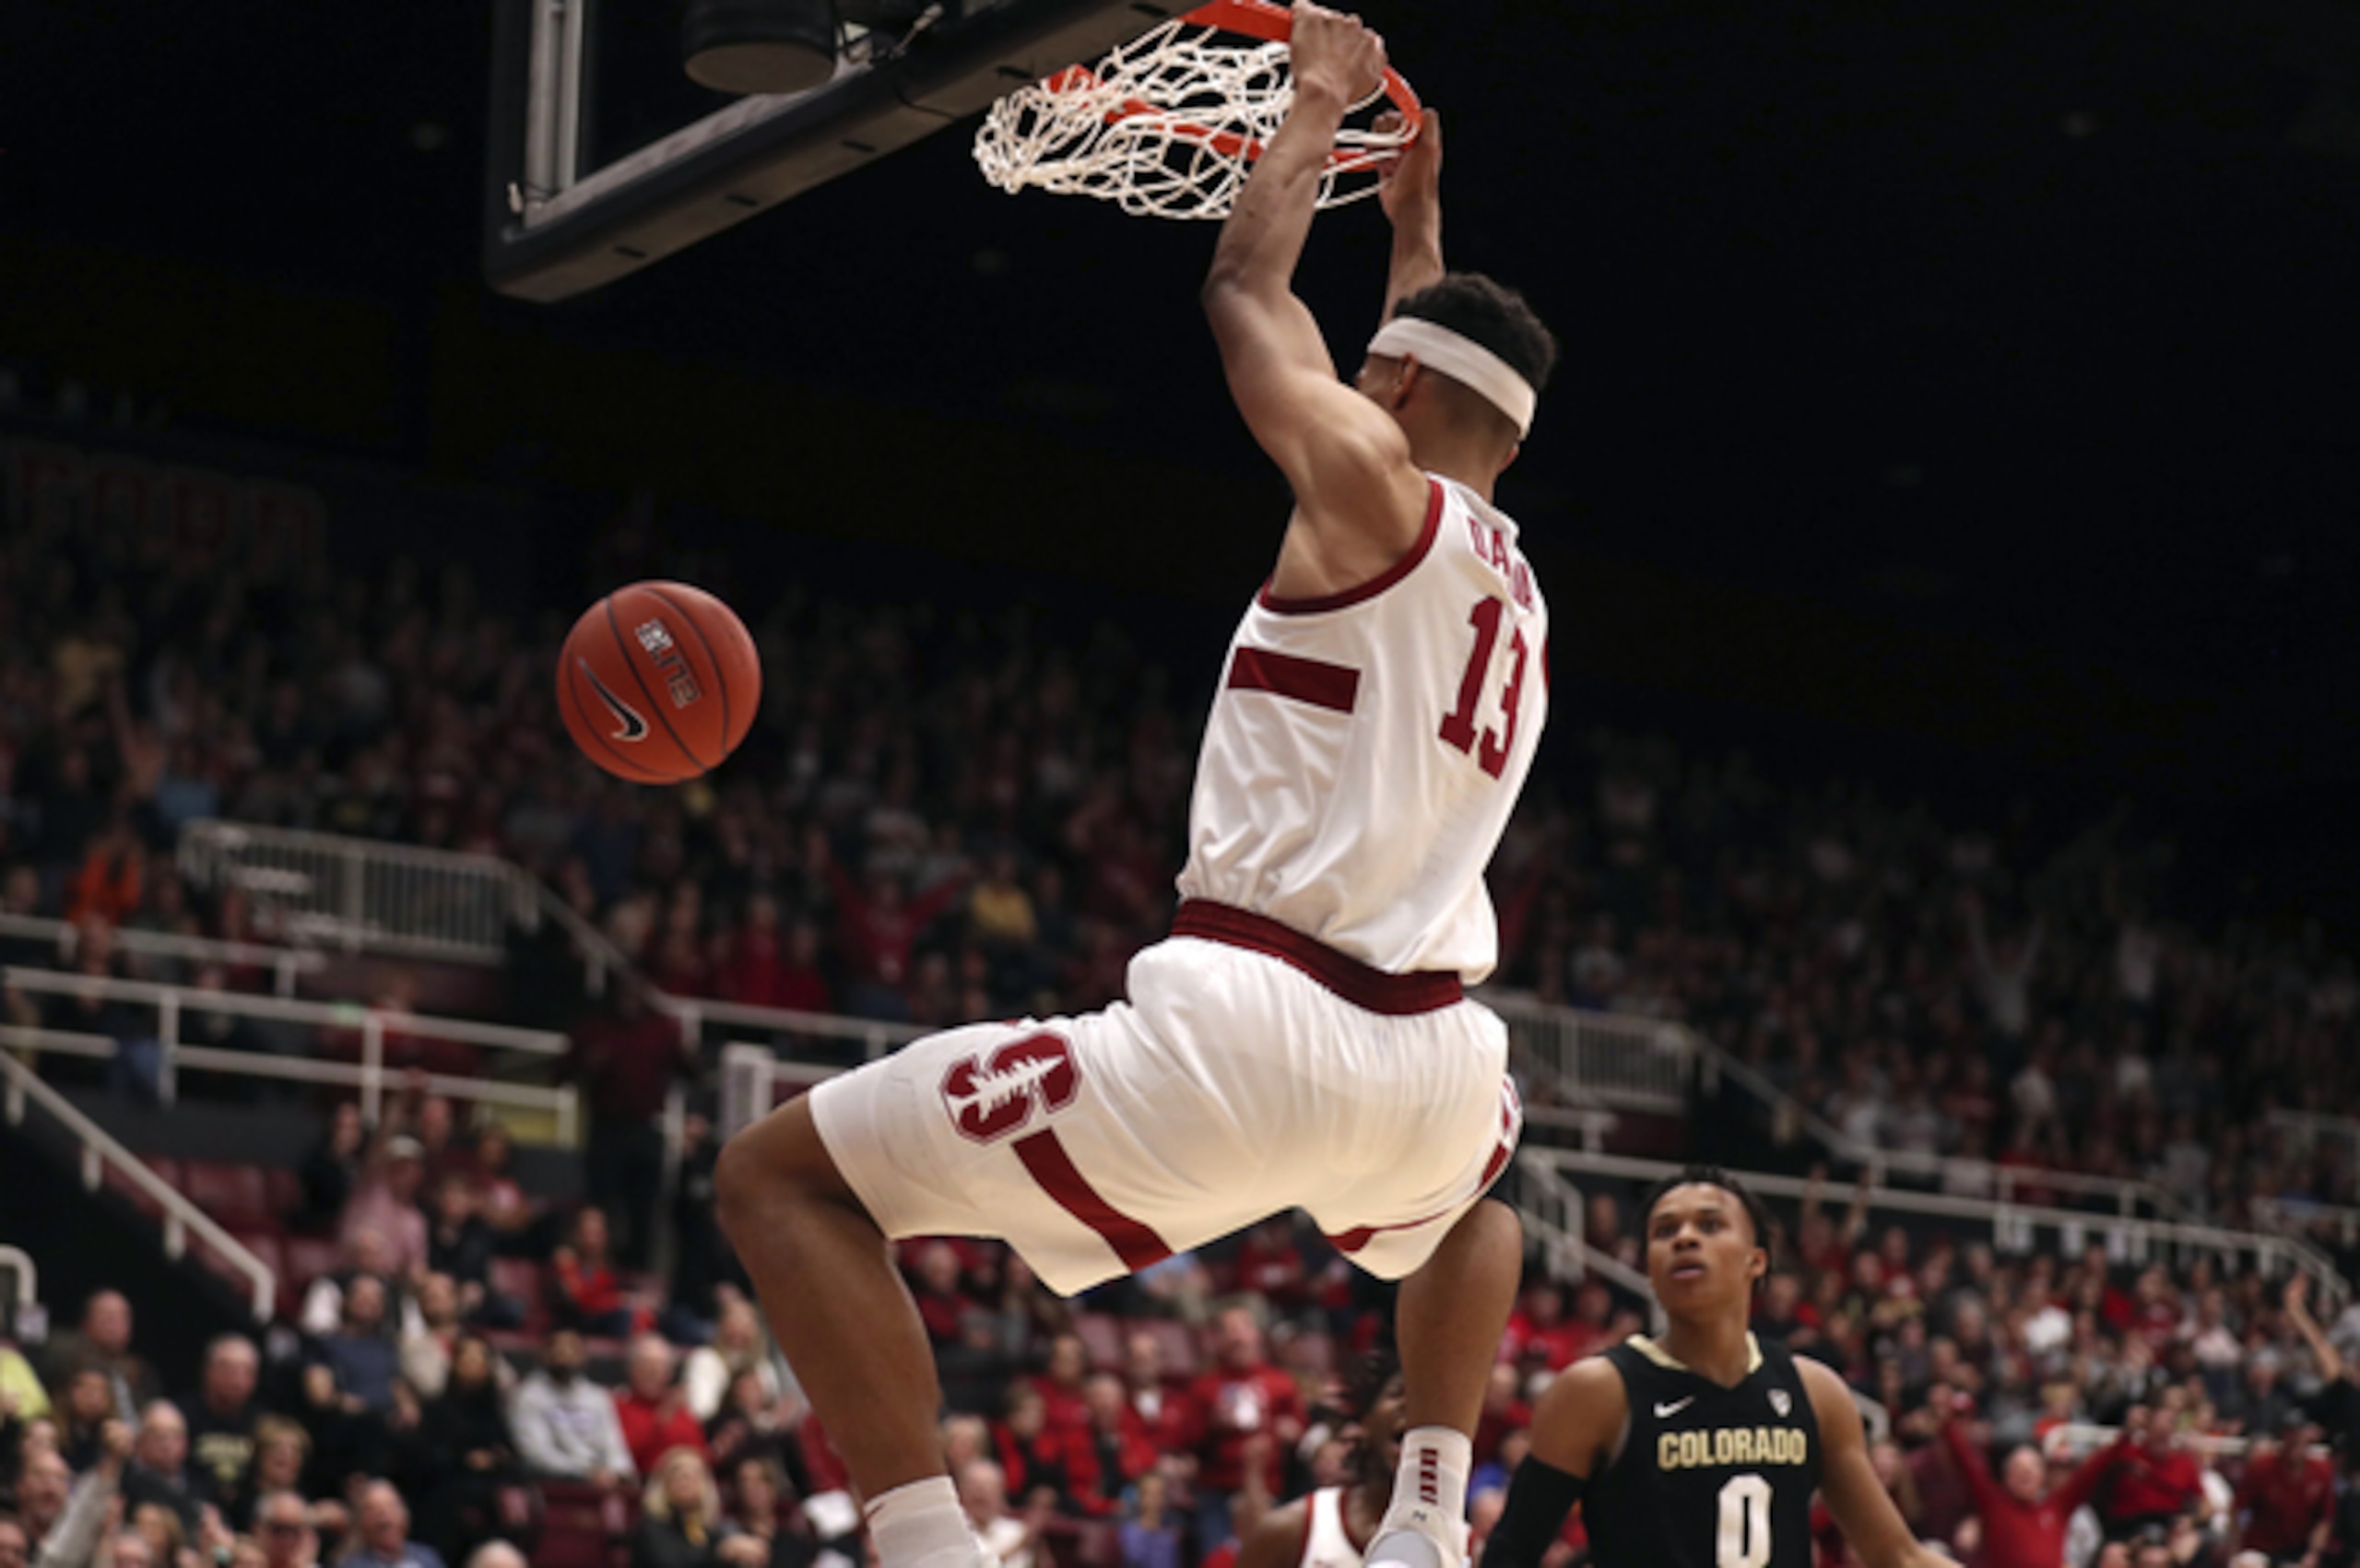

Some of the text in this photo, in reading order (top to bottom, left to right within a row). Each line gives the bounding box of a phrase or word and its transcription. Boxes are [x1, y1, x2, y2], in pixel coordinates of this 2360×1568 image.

[1438, 595, 1528, 781] 13
[1658, 1427, 1807, 1470] COLORADO
[1717, 1474, 1773, 1568] 0
